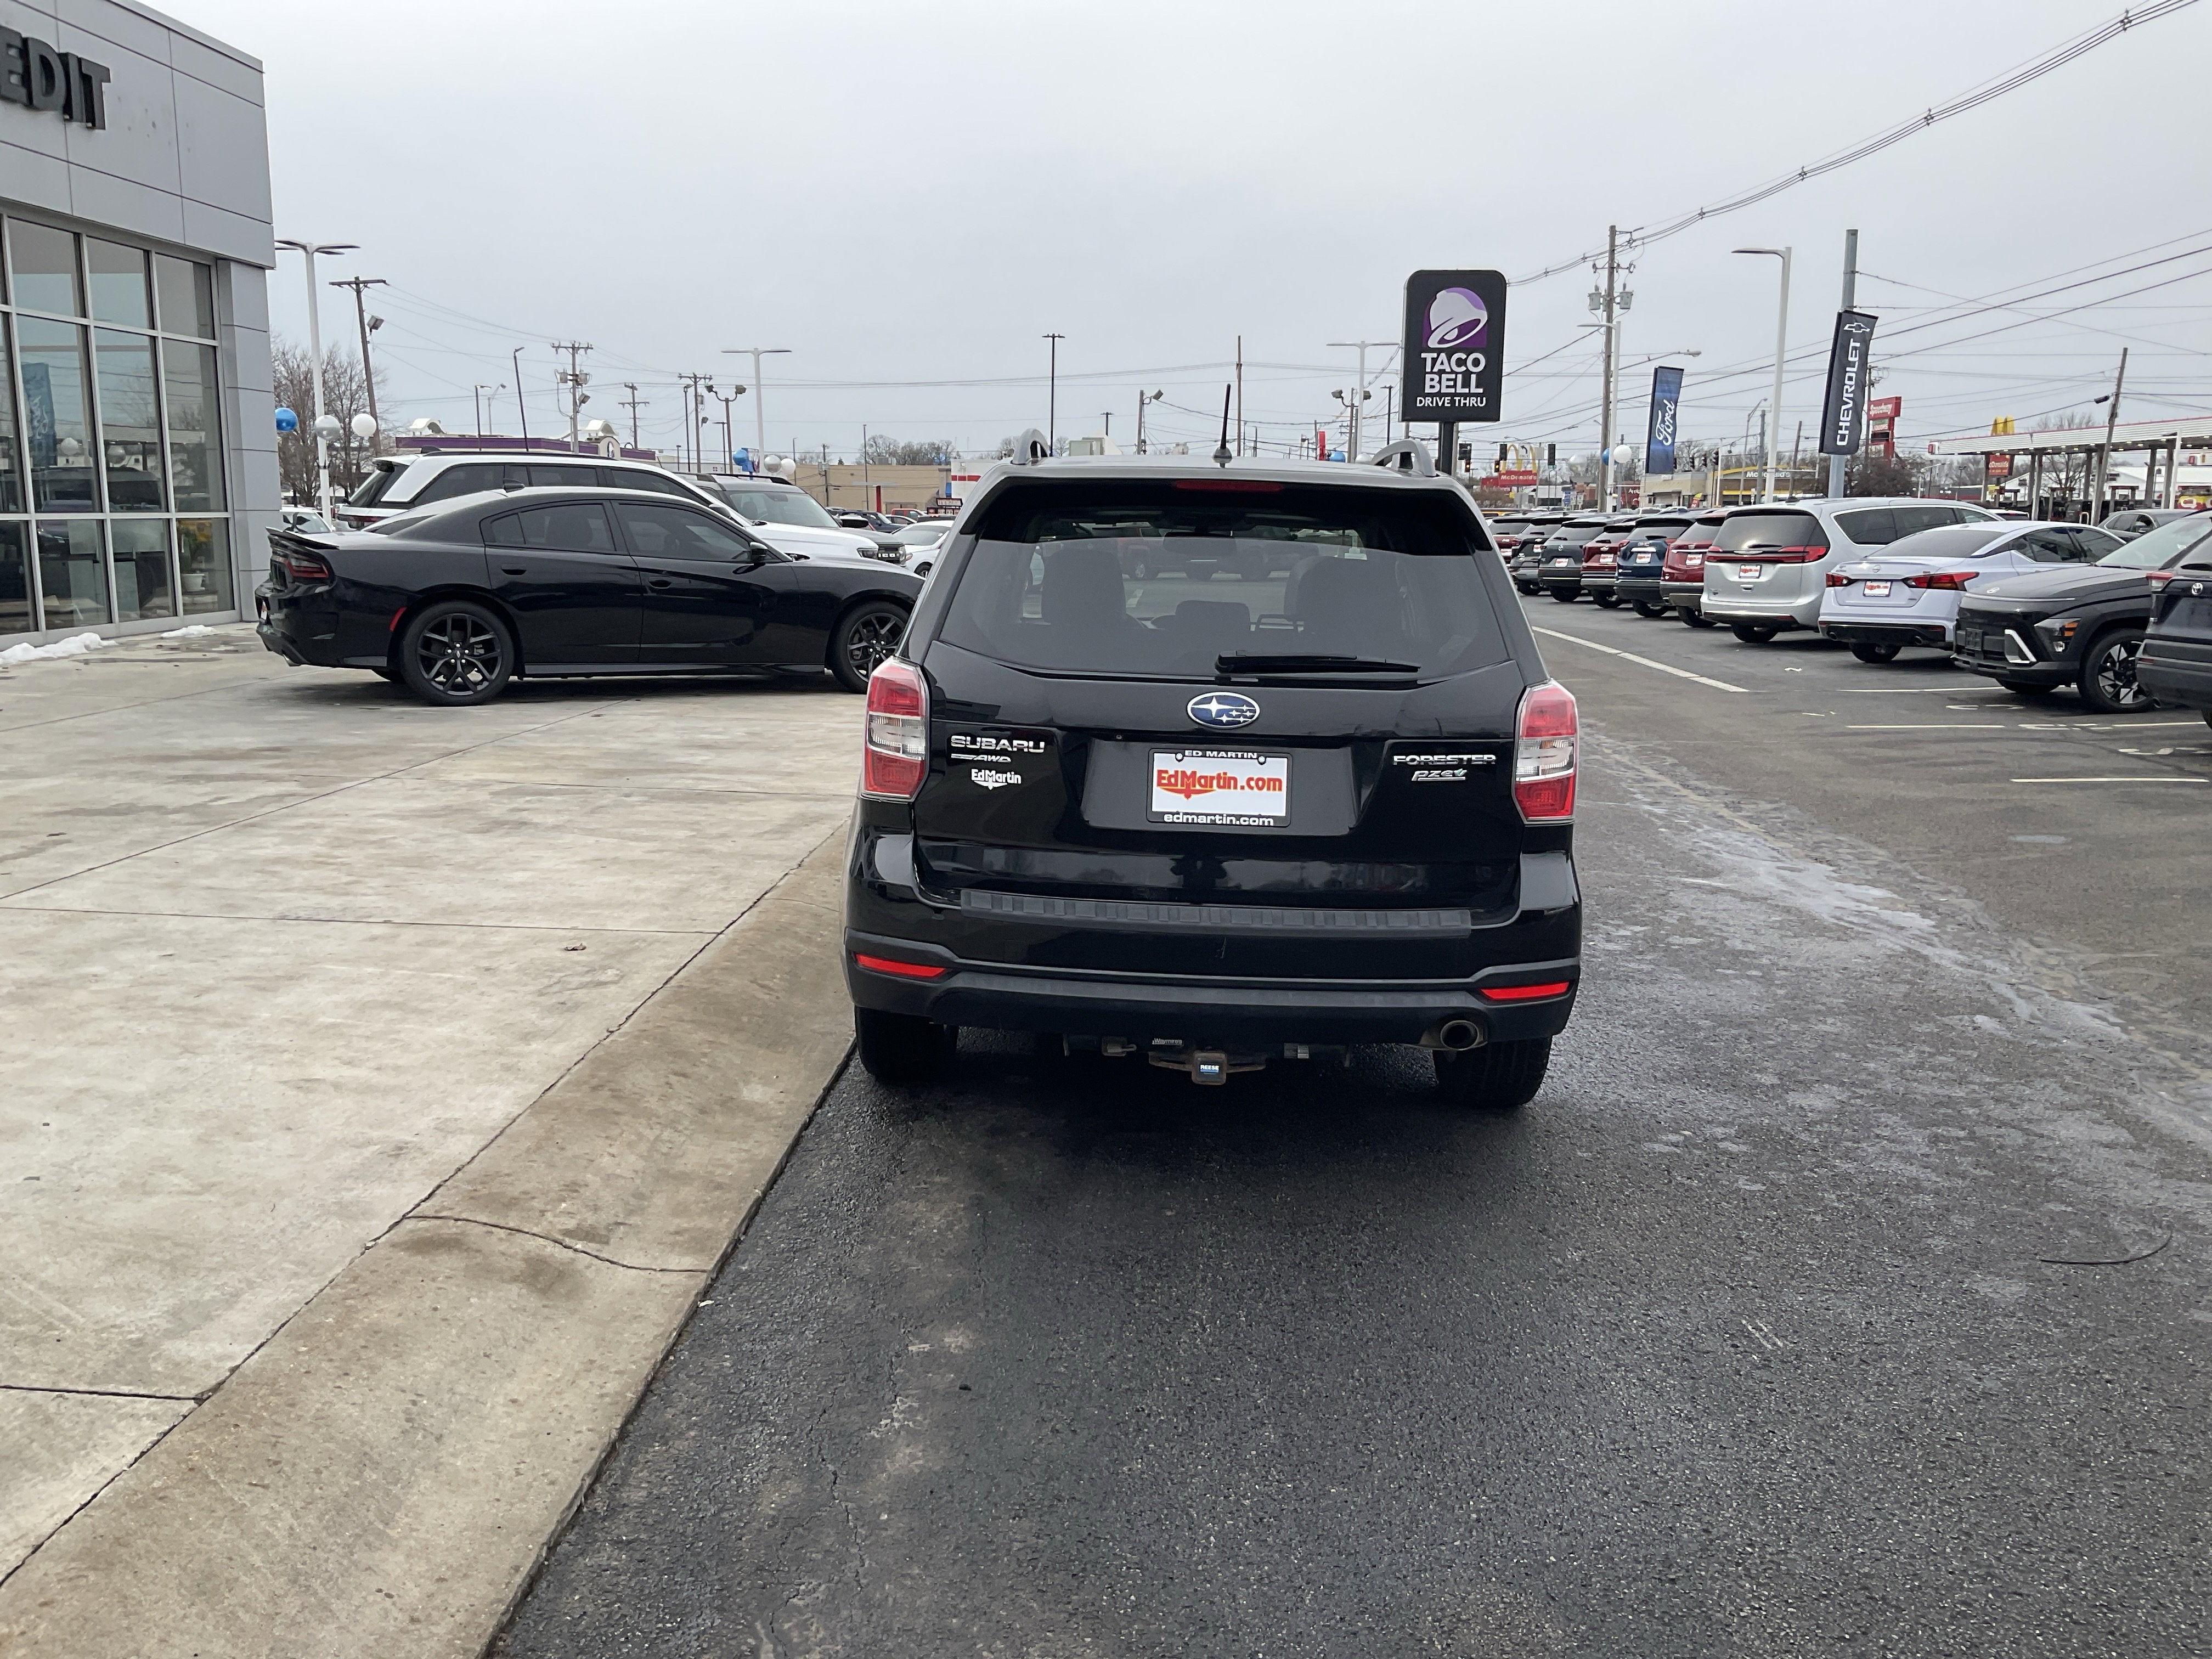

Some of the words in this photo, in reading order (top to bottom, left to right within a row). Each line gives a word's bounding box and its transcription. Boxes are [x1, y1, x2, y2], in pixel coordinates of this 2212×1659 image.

[0, 24, 111, 130] EDIT
[1421, 353, 1486, 373] TACO
[1425, 374, 1484, 393] BELL
[1837, 338, 1860, 446] CHEVROLET
[1417, 397, 1451, 407] DRIVE
[1454, 397, 1486, 407] THRU
[1656, 399, 1675, 445] Ford
[951, 735, 1045, 753] SUBARU
[973, 754, 1011, 763] AWD
[1206, 751, 1257, 759] MARTIN
[1393, 754, 1496, 765] FORESTER
[972, 769, 1022, 785] EdMartin
[1156, 769, 1283, 793] EdMartin.com
[1164, 812, 1273, 826] edmartin.com
